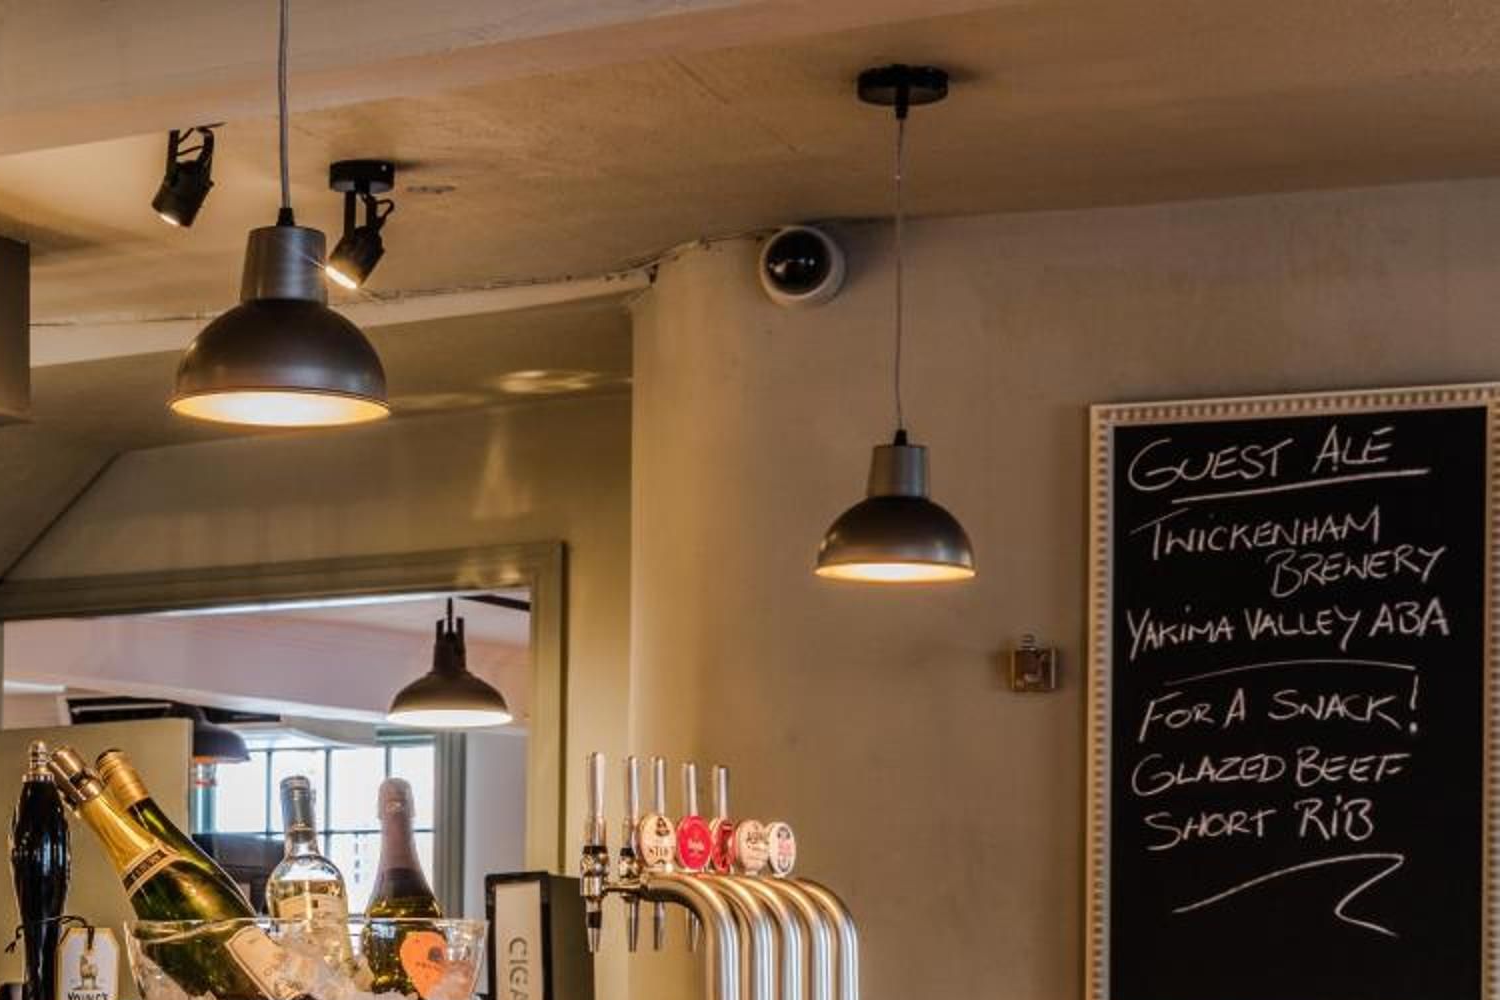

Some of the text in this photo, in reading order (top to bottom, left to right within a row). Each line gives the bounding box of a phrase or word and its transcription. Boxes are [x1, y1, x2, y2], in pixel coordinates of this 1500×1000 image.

[1127, 426, 1394, 492] GUEST ALE
[1130, 506, 1382, 561] TWICKENHAM
[1267, 545, 1446, 598] BREWERY
[1126, 598, 1450, 661] YAKIMA VALLEY ABA
[1139, 675, 1420, 742] FOR A SNACK!
[1130, 746, 1412, 797] GLAZED BEEF
[1145, 794, 1375, 851] SHORT RIB
